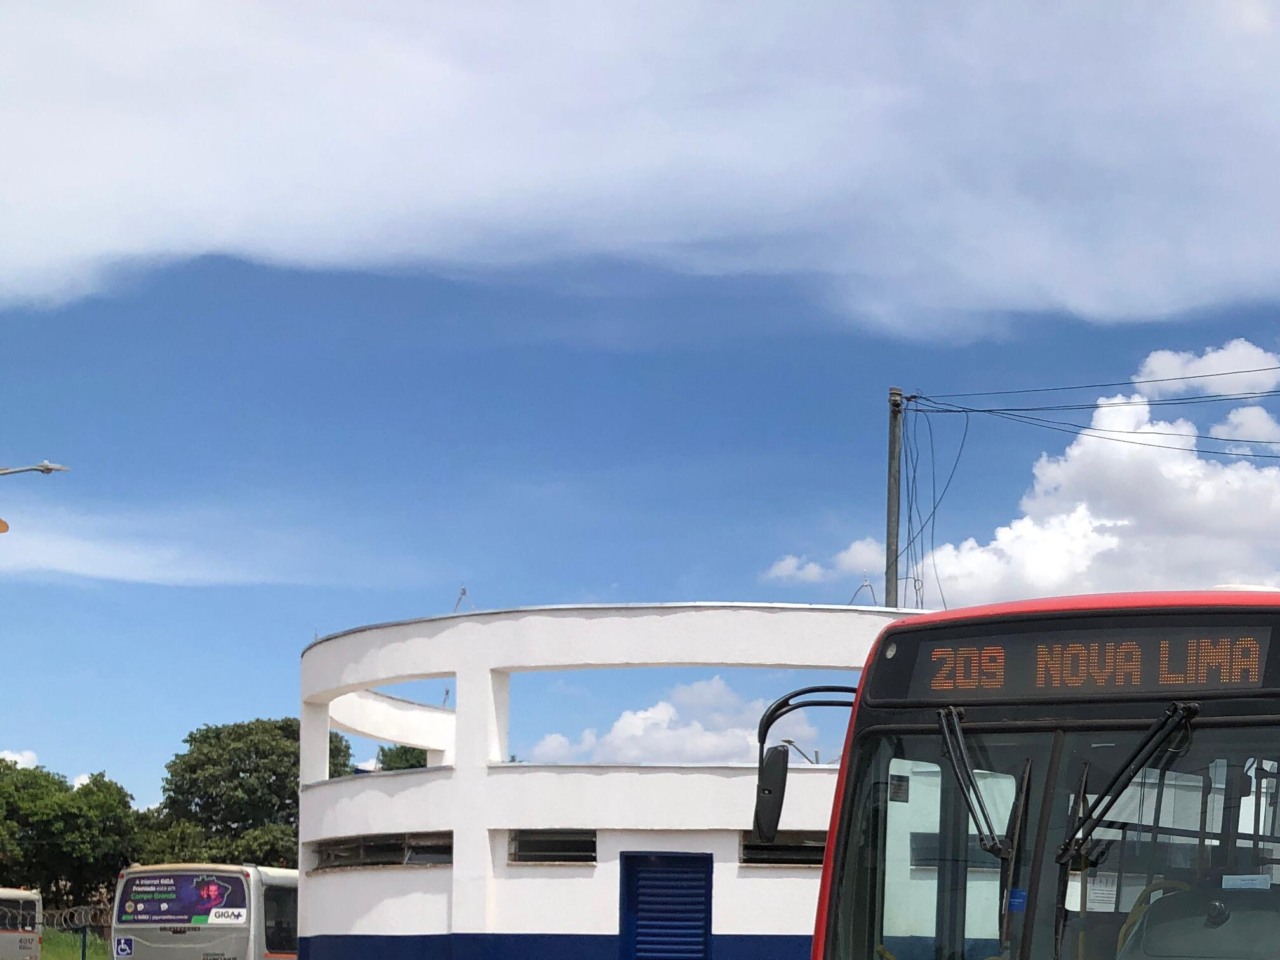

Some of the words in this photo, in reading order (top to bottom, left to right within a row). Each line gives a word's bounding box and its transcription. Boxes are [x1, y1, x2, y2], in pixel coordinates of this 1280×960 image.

[931, 646, 1004, 689] 209
[1036, 641, 1142, 688] NOVA
[1159, 637, 1259, 684] LIMA
